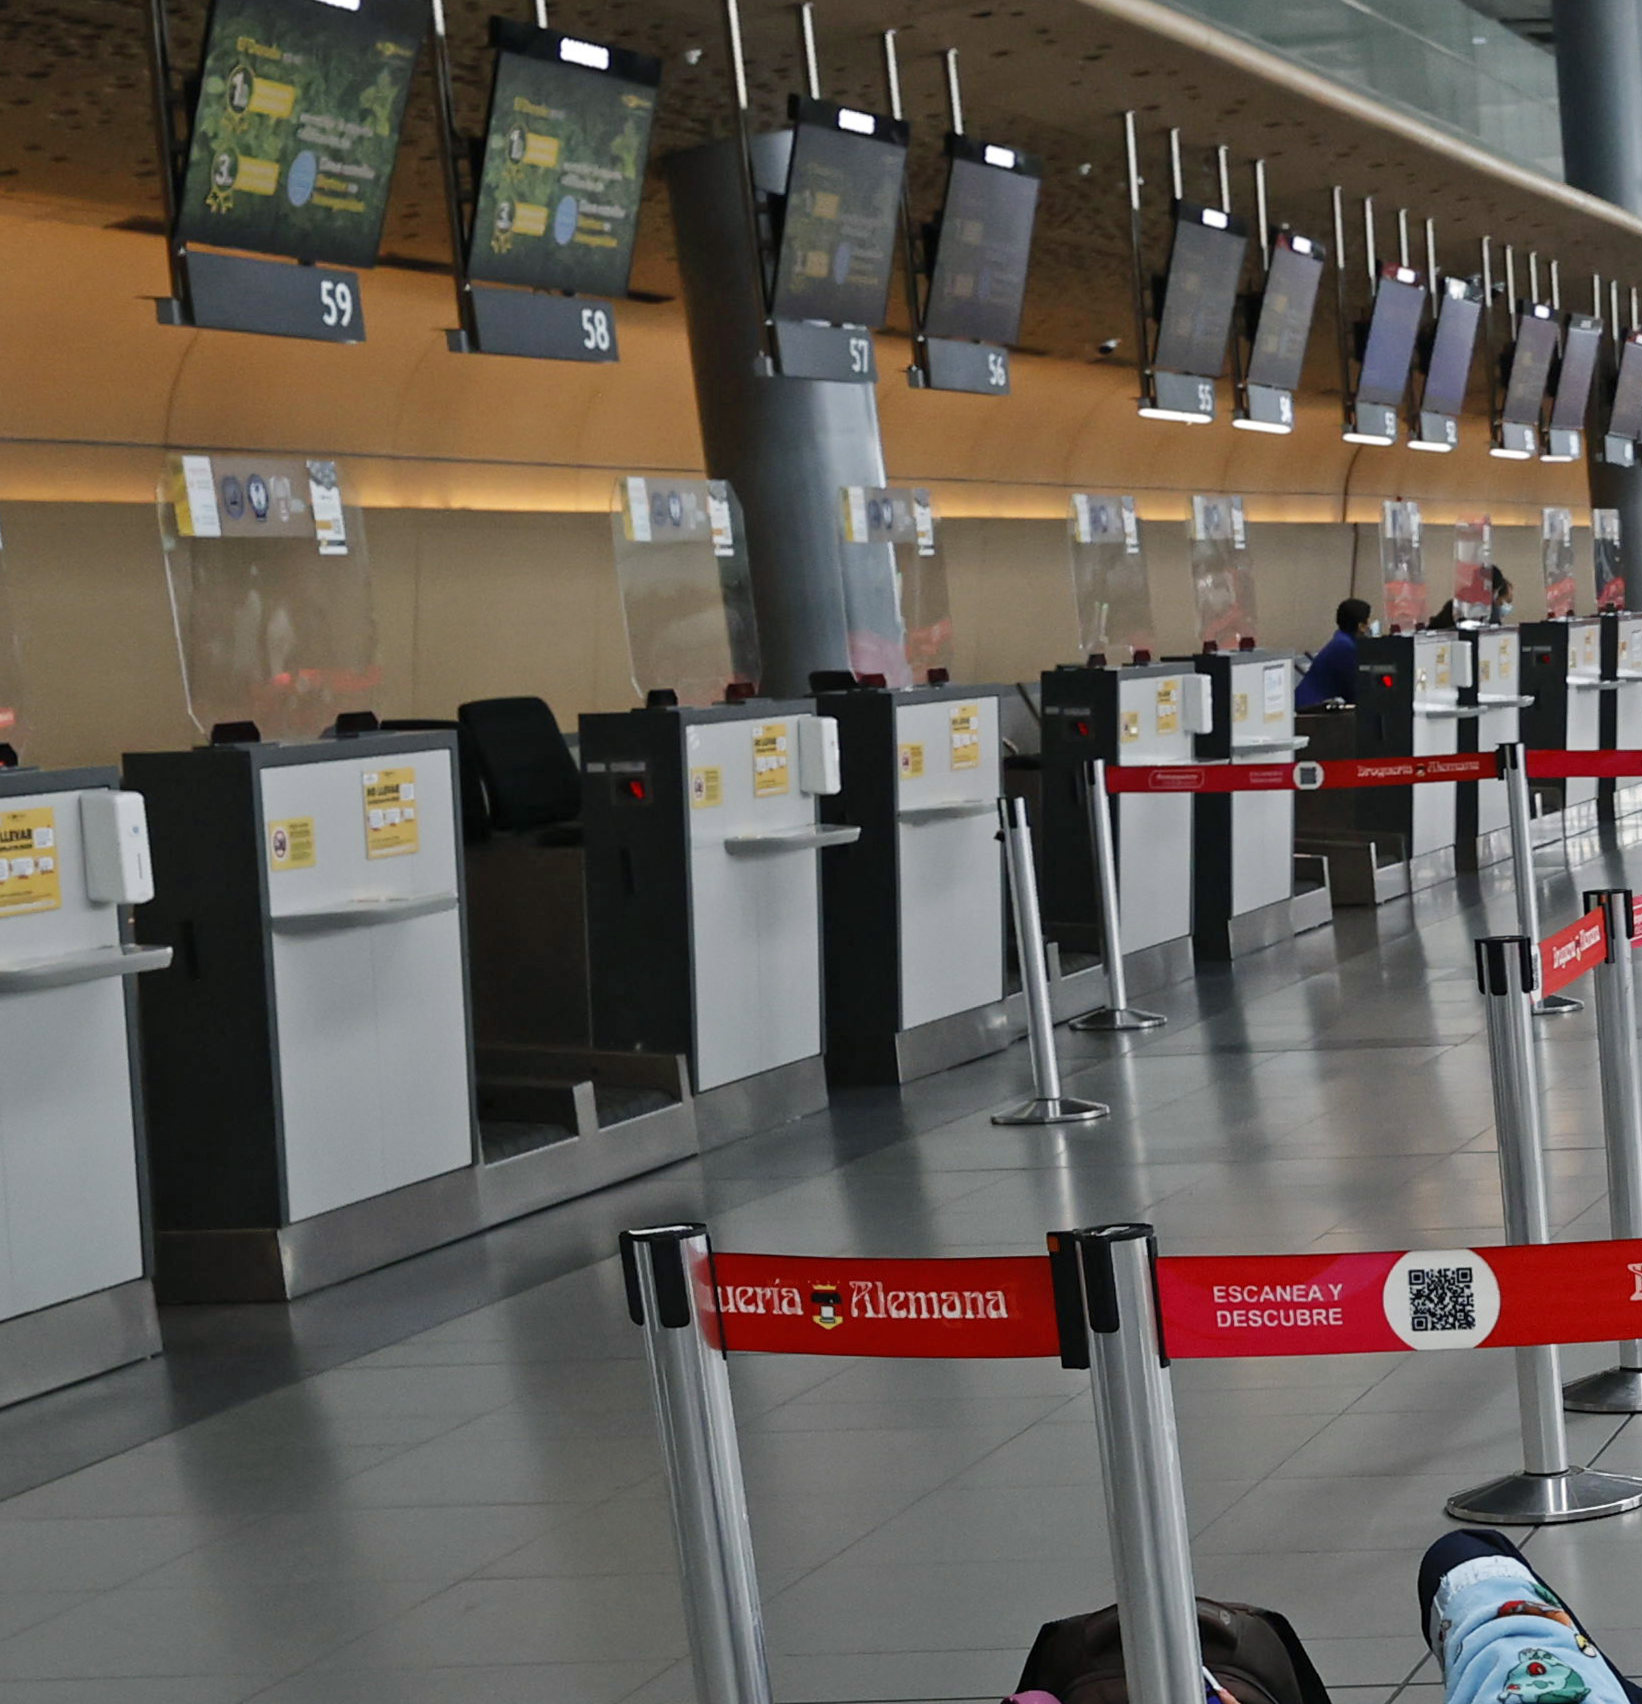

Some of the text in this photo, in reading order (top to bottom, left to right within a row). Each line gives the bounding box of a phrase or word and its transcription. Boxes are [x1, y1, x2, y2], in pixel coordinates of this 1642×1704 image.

[320, 281, 353, 327] 59
[581, 309, 610, 350] 58
[850, 338, 870, 372] 57
[988, 354, 1006, 386] 56
[1198, 384, 1213, 411] 55
[717, 1279, 1008, 1318] uería Alemana
[1213, 1284, 1342, 1302] ESCANEA Y
[1217, 1308, 1343, 1327] DESCUBRE
